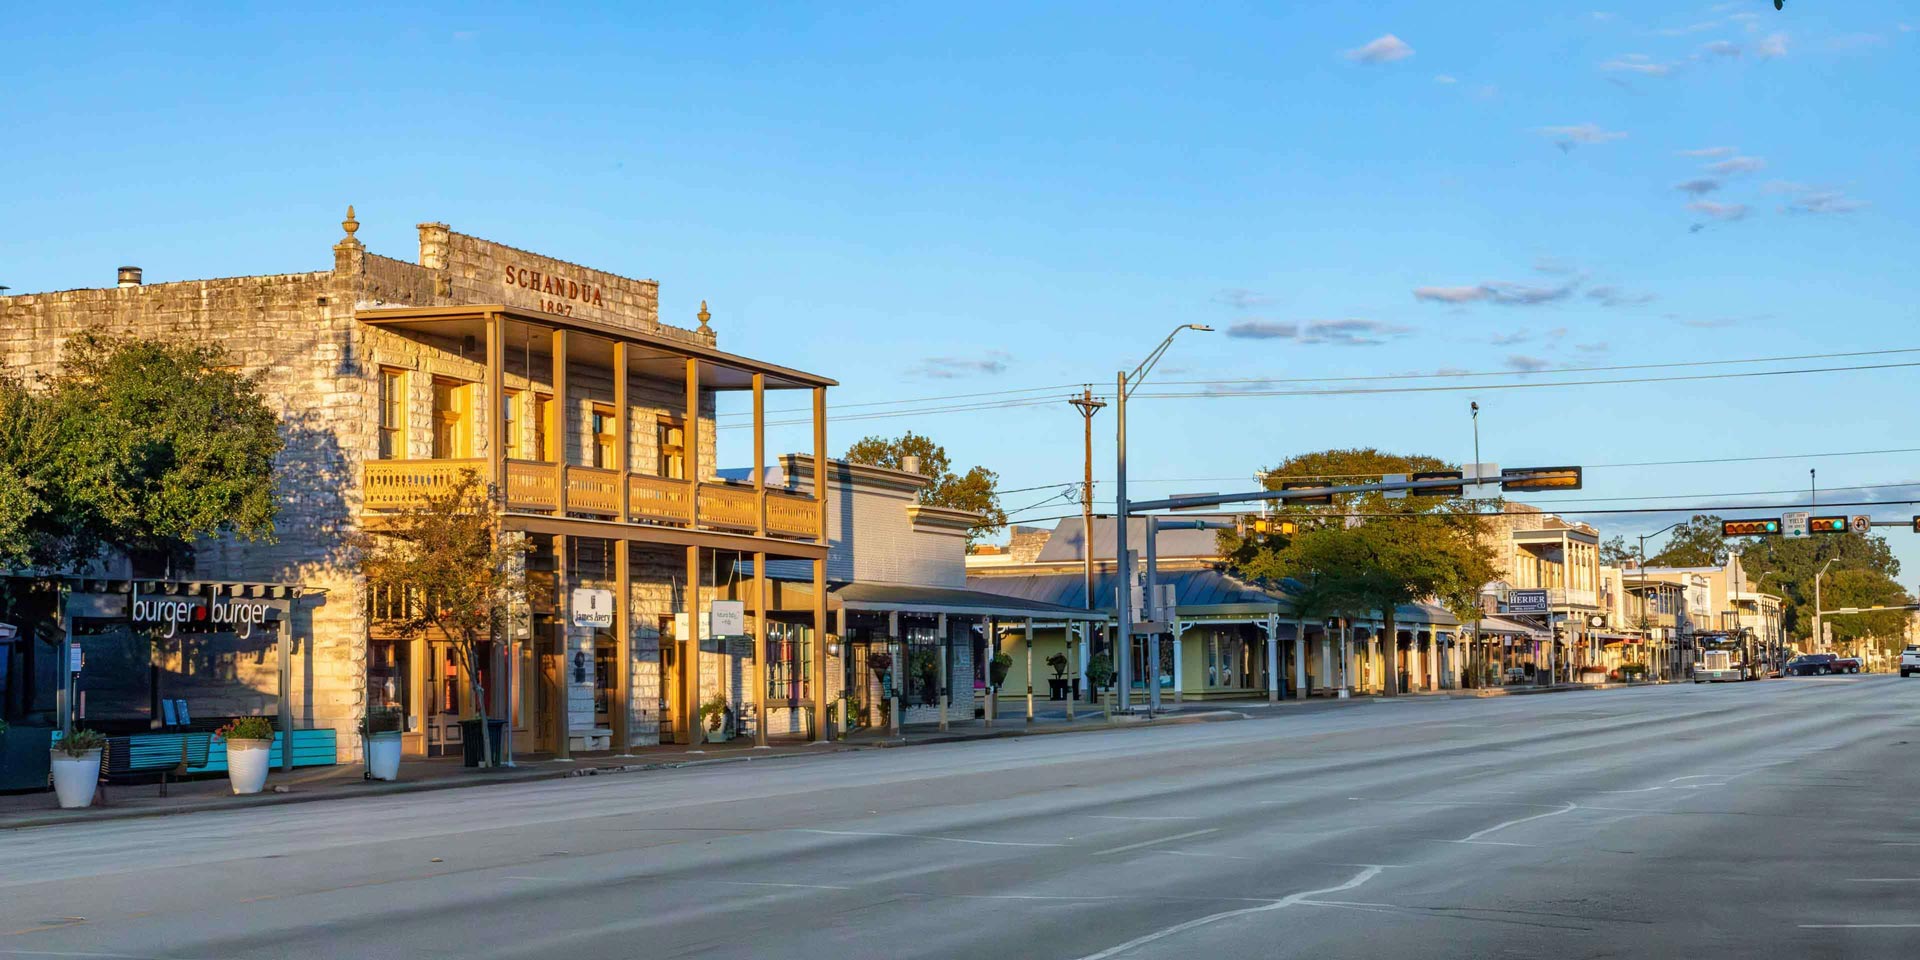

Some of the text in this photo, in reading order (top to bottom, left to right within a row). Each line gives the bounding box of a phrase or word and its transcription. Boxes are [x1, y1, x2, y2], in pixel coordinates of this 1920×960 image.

[505, 265, 604, 307] SCHANDUA
[539, 298, 573, 316] 1897
[1510, 596, 1545, 604] HERBER
[132, 582, 270, 640] burger burger
[575, 610, 610, 624] James Avery
